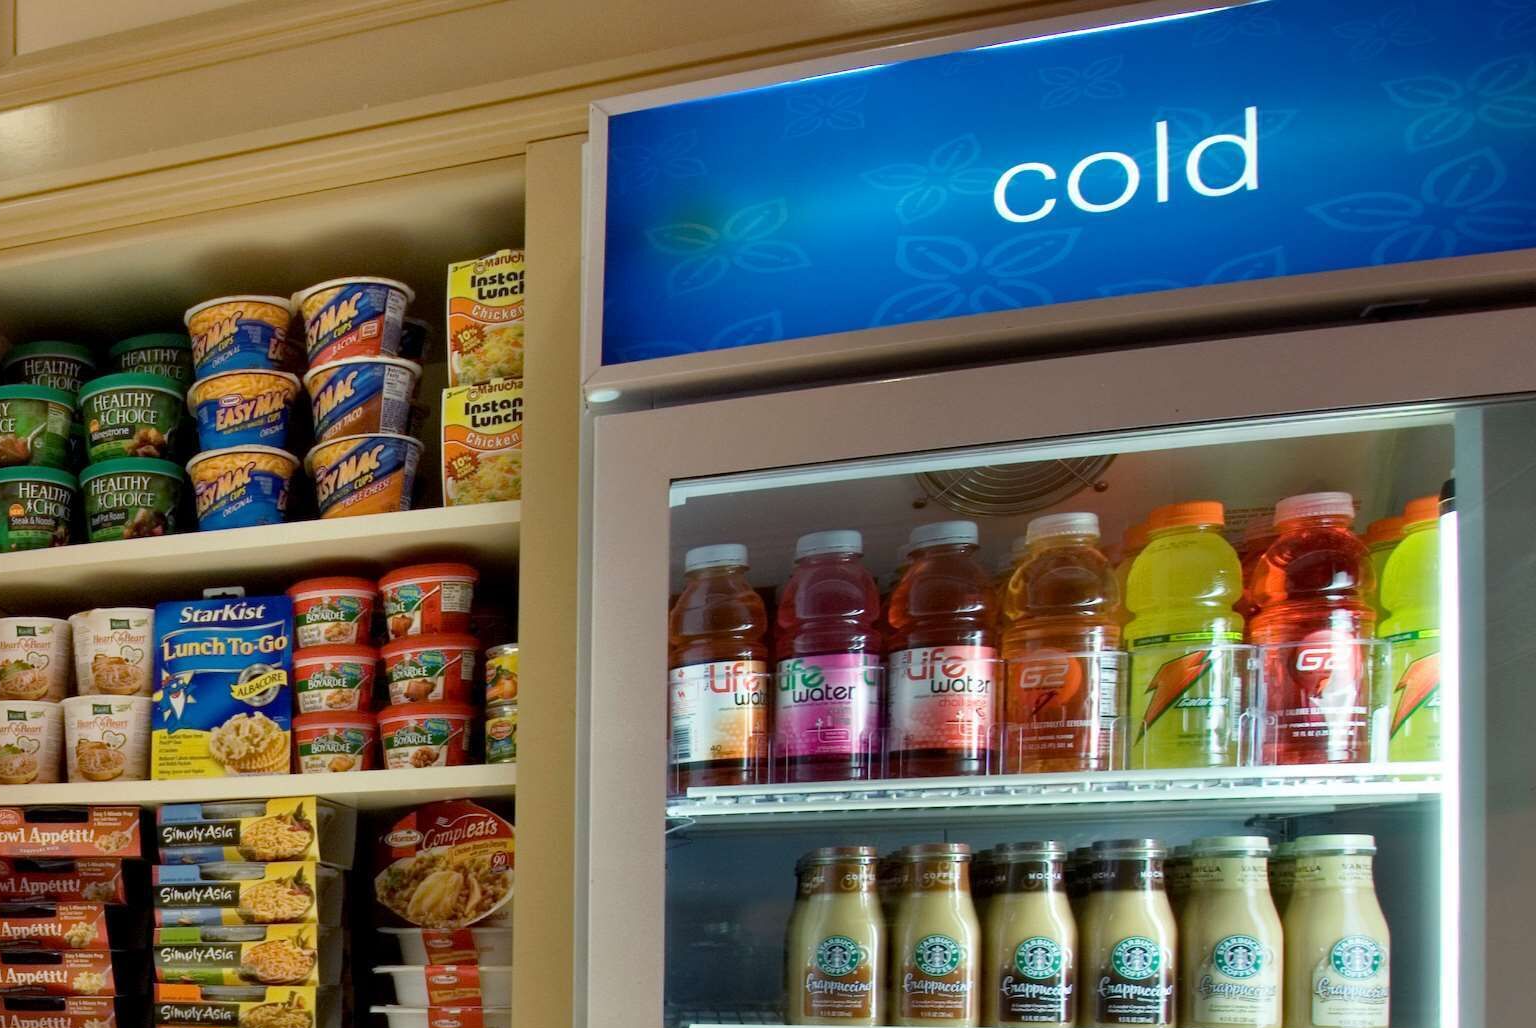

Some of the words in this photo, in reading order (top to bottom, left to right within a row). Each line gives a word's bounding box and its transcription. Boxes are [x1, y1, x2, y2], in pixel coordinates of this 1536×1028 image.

[993, 106, 1258, 223] cold
[122, 349, 180, 367] HEALTHY
[24, 360, 81, 378] HEALTHY
[93, 391, 154, 414] HEALTHY
[464, 397, 523, 416] Instan
[107, 408, 157, 426] CHOICE
[216, 400, 257, 432] EASY
[472, 408, 523, 428] Lunch
[466, 432, 520, 448] Chicken
[337, 444, 385, 490] MAC
[91, 475, 151, 497] HEALTHY
[217, 461, 256, 500] MAC
[18, 482, 72, 505] HEALTHY
[102, 491, 155, 510] CHOICE
[179, 602, 266, 624] StarKist
[306, 610, 345, 624] BOYARDEE
[163, 636, 224, 660] Lunch
[907, 647, 967, 682] Life
[1295, 647, 1350, 672] G2
[237, 671, 283, 698] ALBACORE
[308, 677, 348, 690] BOYARDEE
[929, 676, 991, 694] water
[1019, 664, 1070, 690] G2
[791, 683, 857, 704] water
[311, 741, 351, 754] BOYARDEE
[393, 734, 433, 747] BOYARDEE
[28, 827, 95, 846] Appétit!
[163, 828, 203, 845] Simply
[203, 825, 236, 840] Asia
[422, 815, 498, 851] Compleats
[493, 854, 506, 864] 90
[19, 878, 81, 895] Appétit!
[160, 886, 202, 904] Simply
[202, 885, 235, 901] Asia
[0, 922, 62, 938] Appétit!
[160, 947, 202, 964] Simply
[203, 946, 236, 961] Asia
[5, 967, 68, 984] Appétit!
[820, 964, 856, 977] COFFEE
[919, 964, 956, 977] COFFEE
[1020, 965, 1058, 980] COFFEE
[1118, 966, 1155, 980] COFFEE
[1222, 965, 1259, 980] COFFEE
[903, 974, 973, 993] Frappuccino
[160, 1006, 202, 1023] Simply
[202, 1005, 235, 1021] Asia
